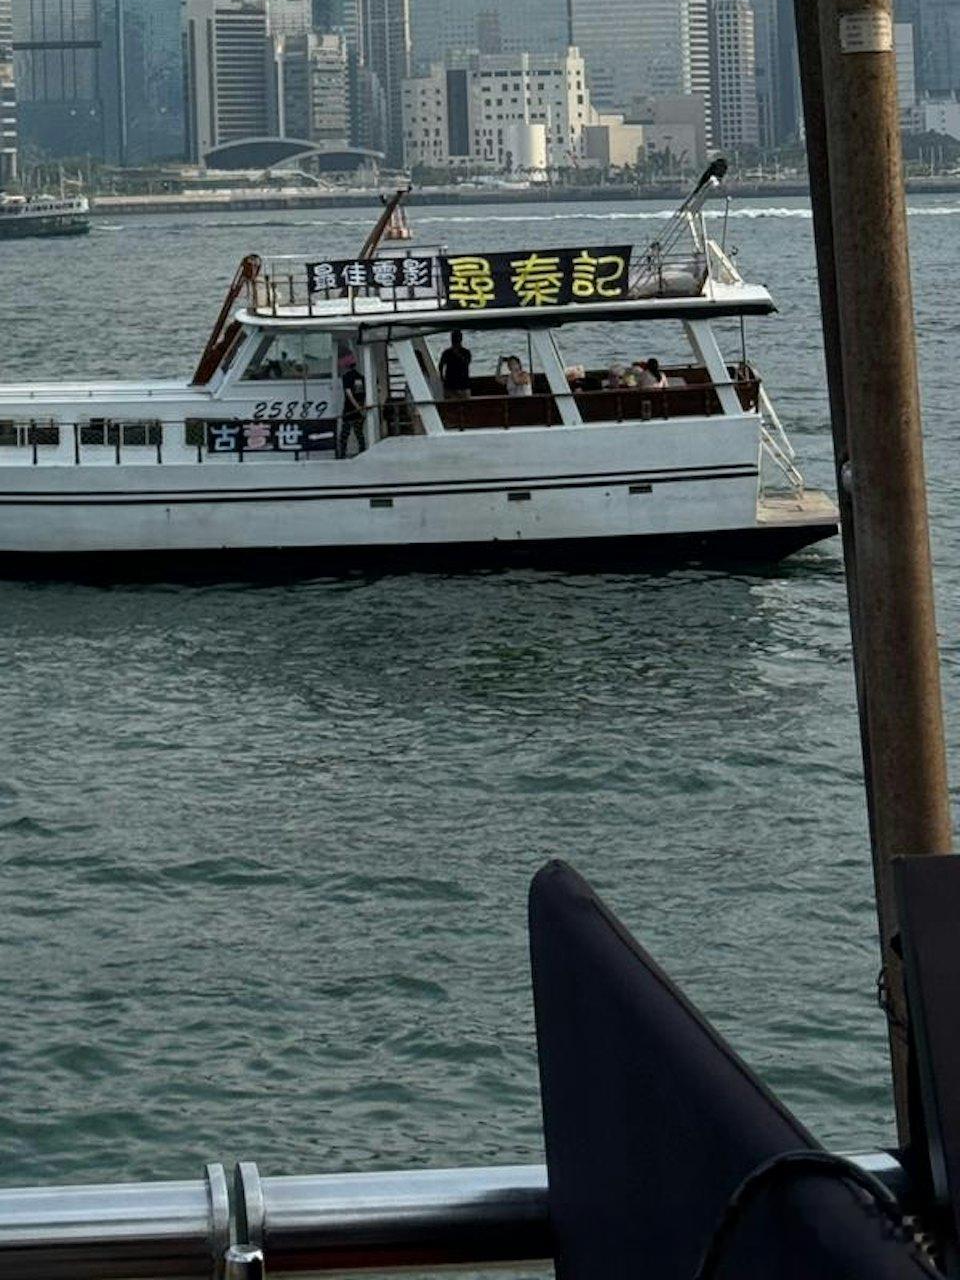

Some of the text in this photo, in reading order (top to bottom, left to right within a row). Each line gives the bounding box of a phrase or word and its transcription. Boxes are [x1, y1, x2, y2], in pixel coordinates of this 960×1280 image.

[312, 257, 429, 291] 最佳電影
[446, 249, 627, 310] 尋秦記
[252, 400, 328, 420] 25889
[209, 422, 335, 452] 古萱世一
